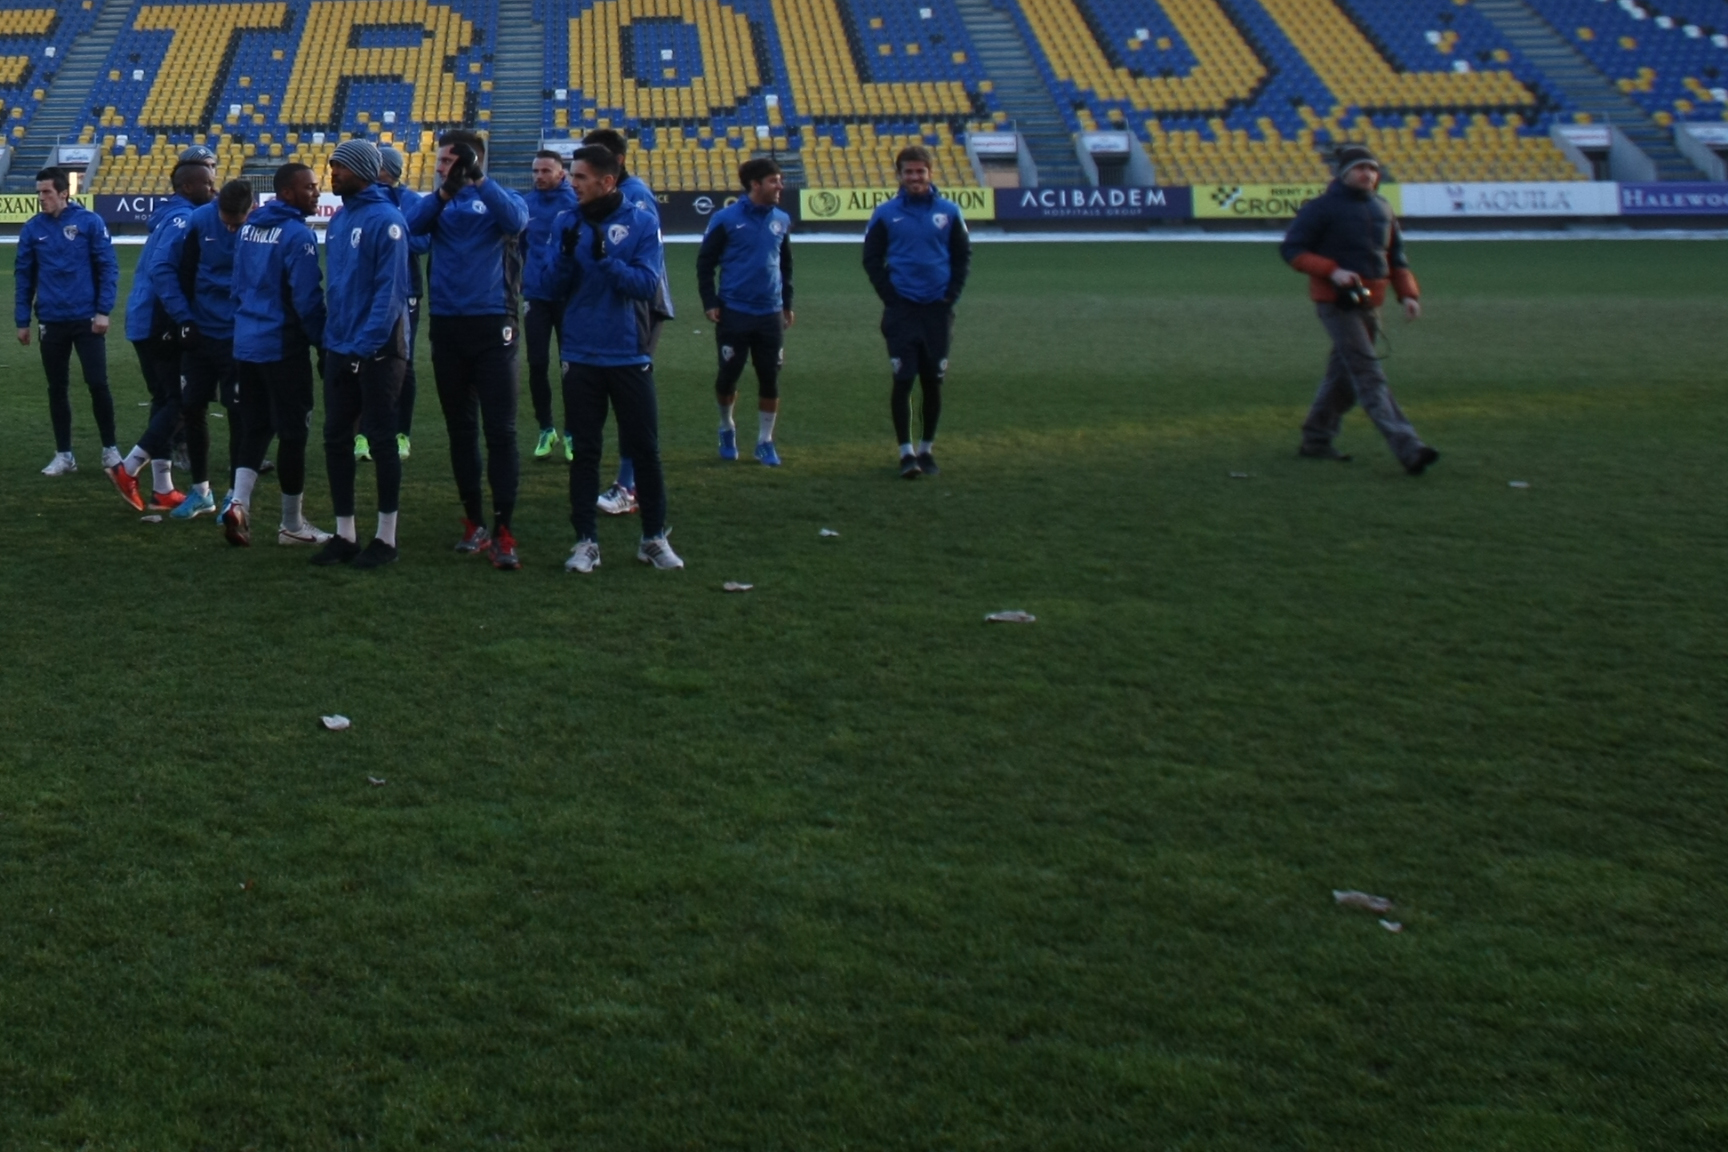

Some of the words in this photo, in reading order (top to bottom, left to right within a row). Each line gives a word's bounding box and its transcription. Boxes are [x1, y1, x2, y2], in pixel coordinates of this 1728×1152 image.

[1021, 189, 1166, 207] ACIBADEM
[1478, 190, 1571, 210] AQUILA
[1044, 208, 1100, 216] HOSPITALS
[1107, 207, 1142, 215] GROUP
